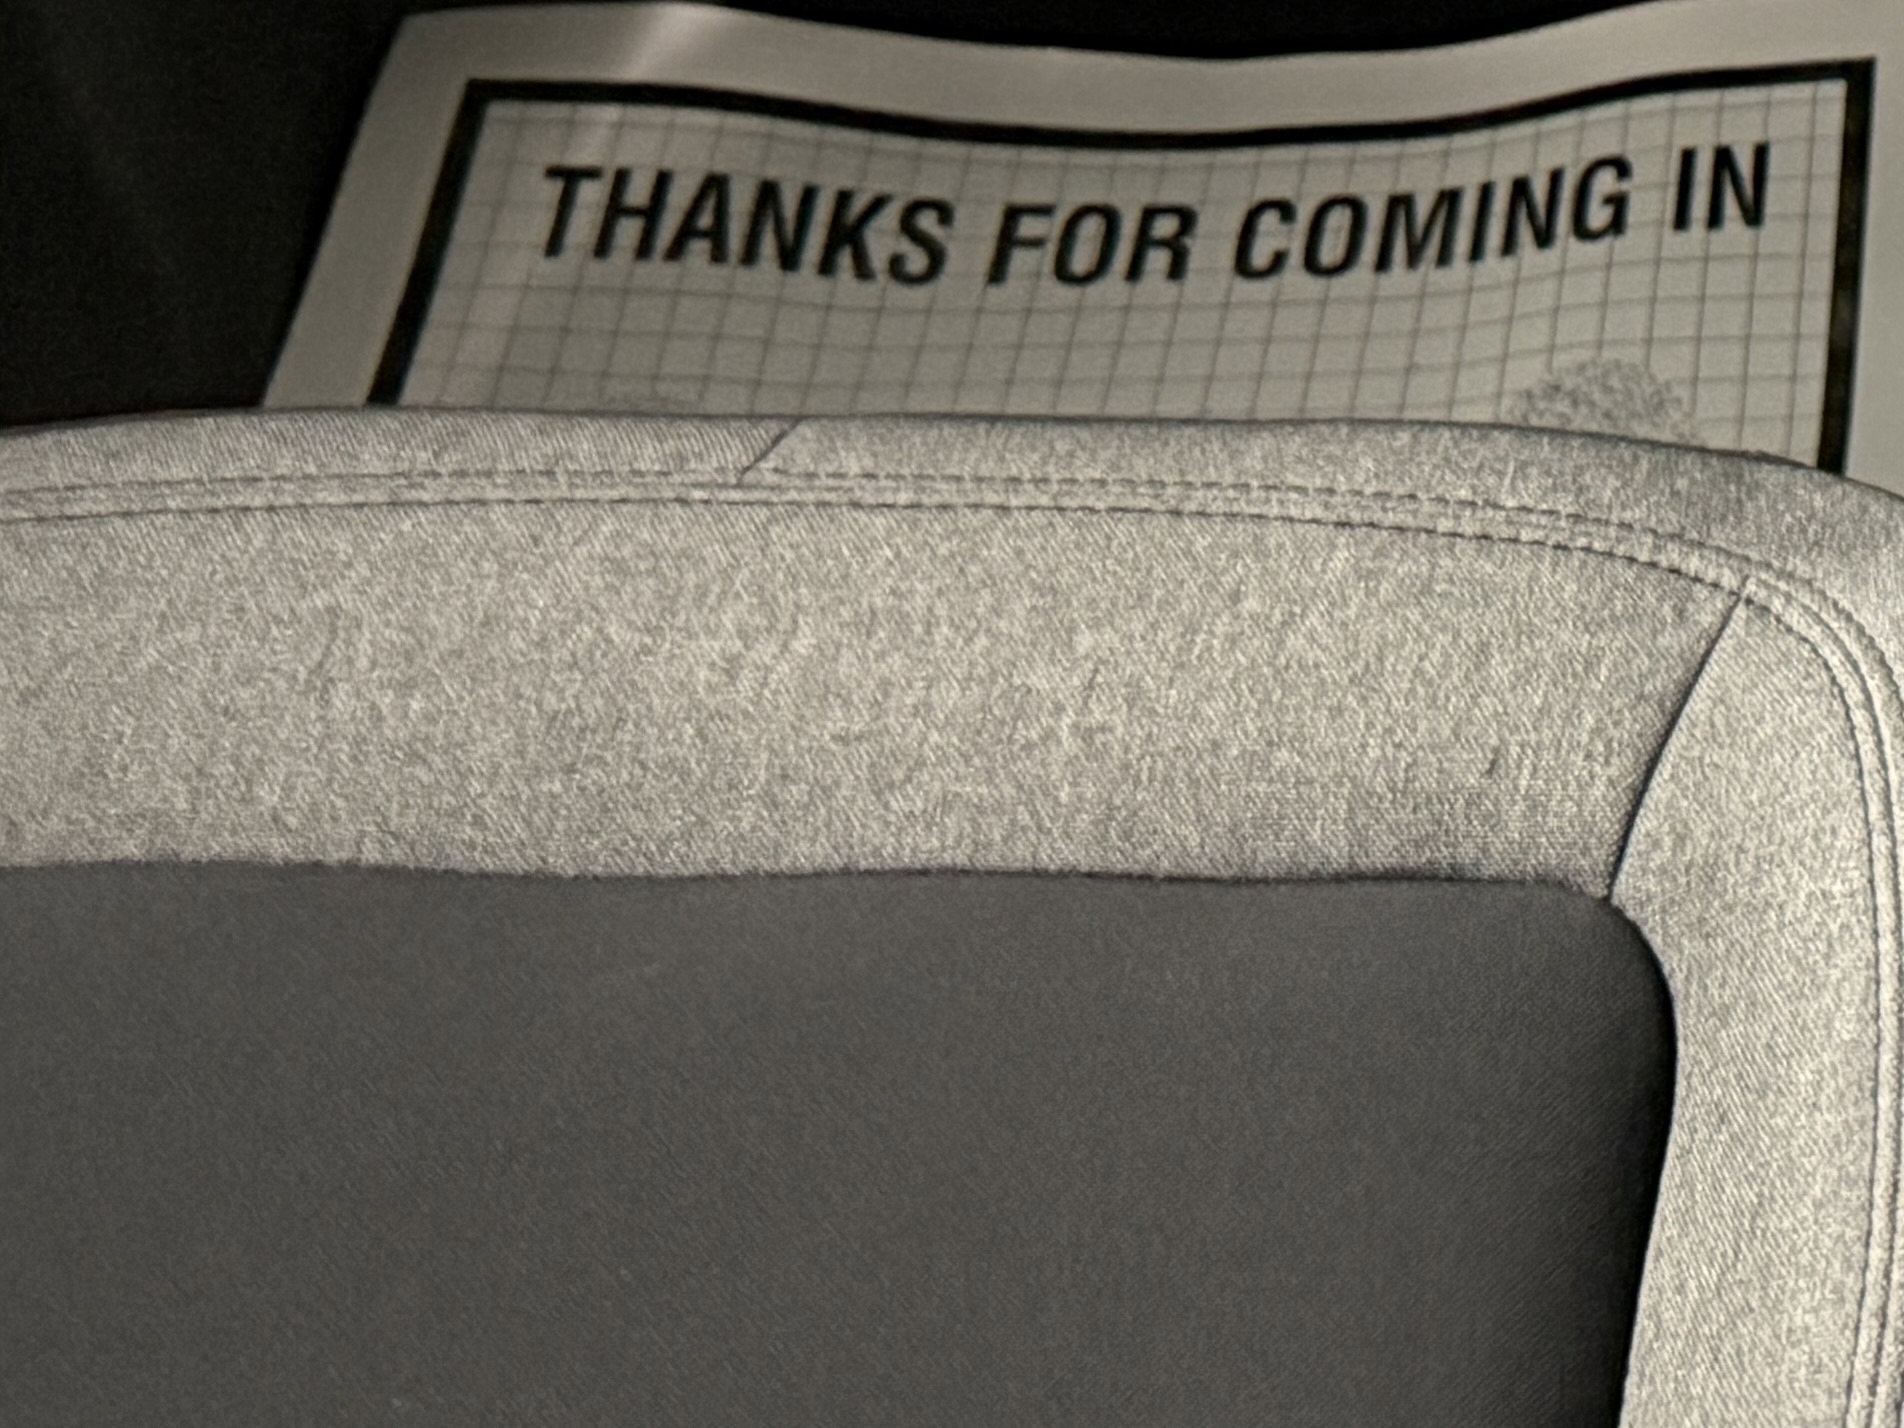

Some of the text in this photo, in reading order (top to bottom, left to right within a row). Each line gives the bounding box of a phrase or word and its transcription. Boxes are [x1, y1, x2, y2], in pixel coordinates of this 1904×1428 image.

[541, 144, 1771, 289] THANKS FOR COMING IN
